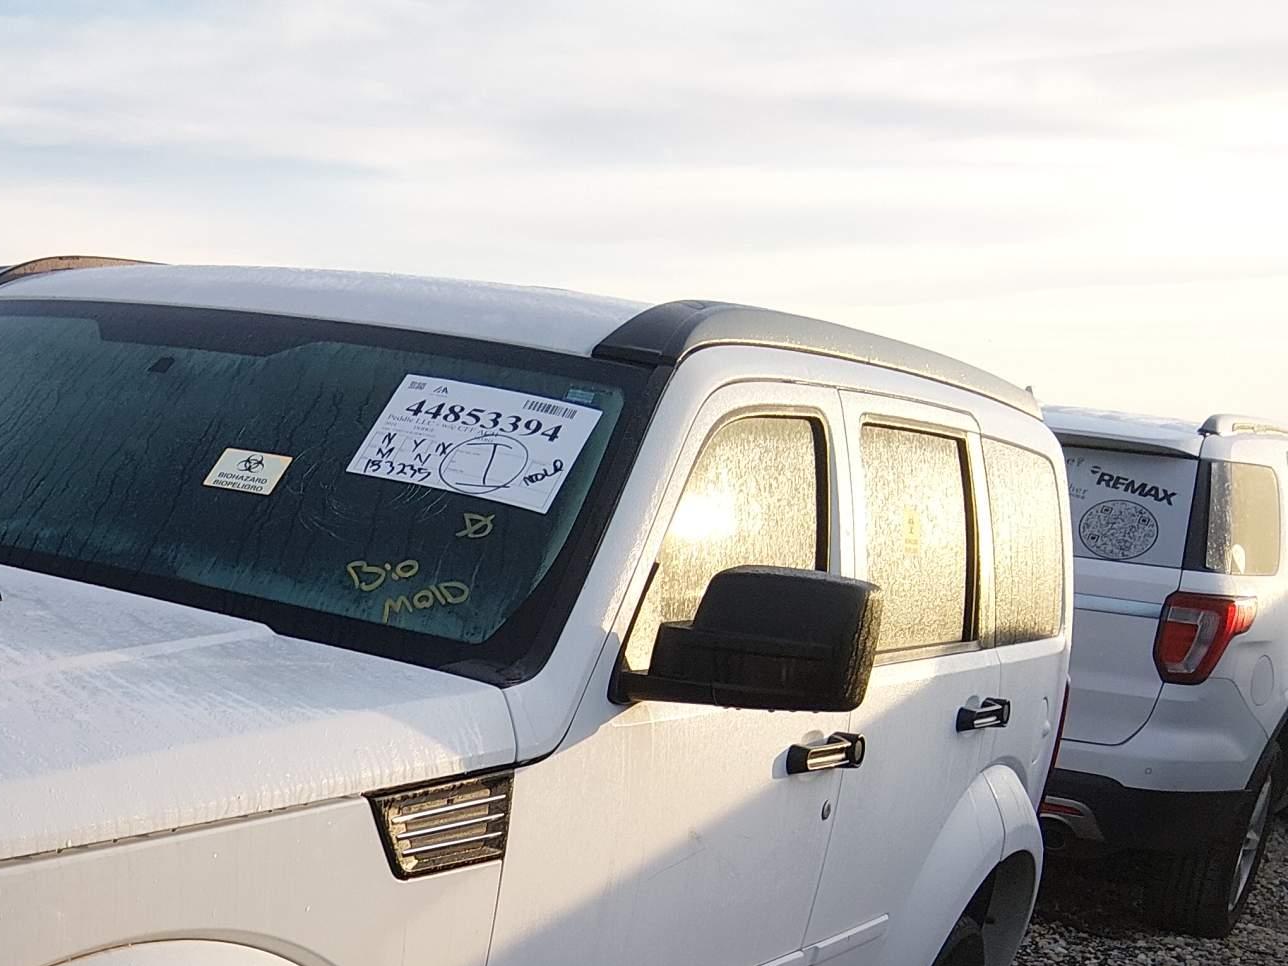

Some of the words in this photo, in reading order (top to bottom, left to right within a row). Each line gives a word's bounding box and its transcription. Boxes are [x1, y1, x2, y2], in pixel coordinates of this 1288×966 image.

[405, 399, 563, 443] 44853394
[212, 479, 264, 492] BIOPELIGRO
[217, 471, 269, 486] BIOHAZARD
